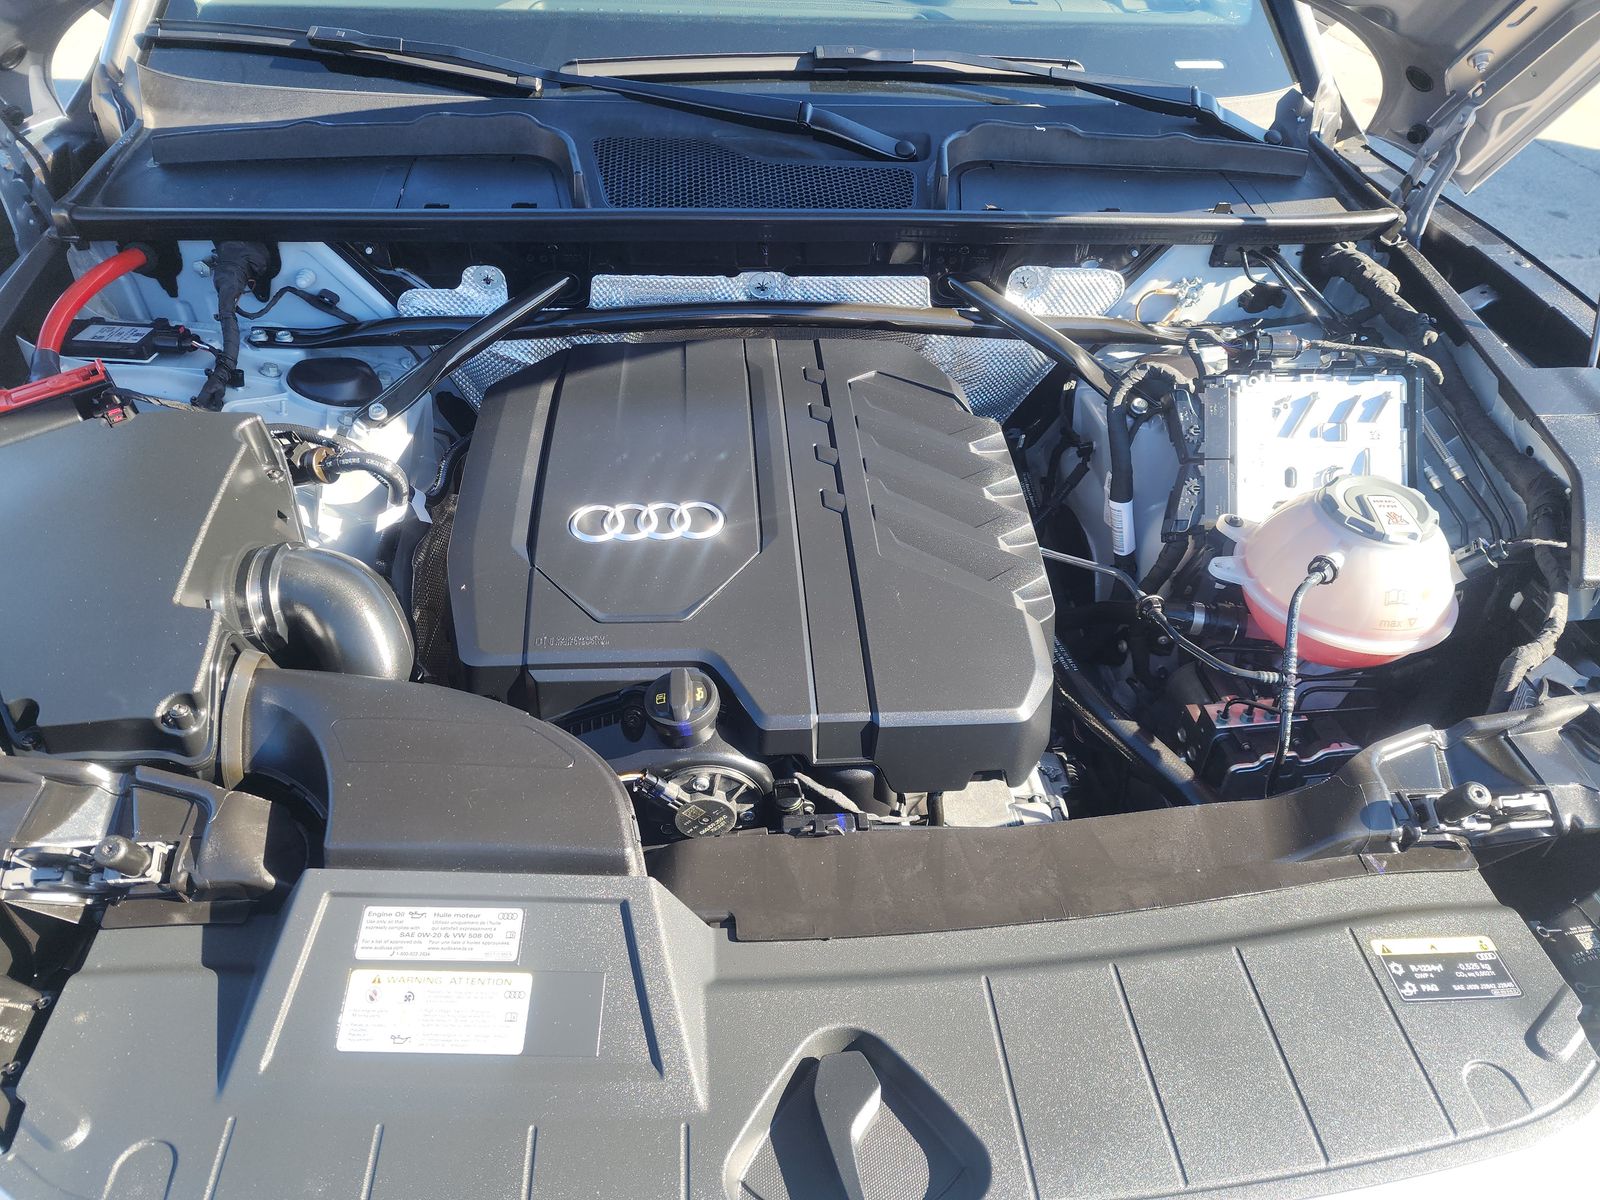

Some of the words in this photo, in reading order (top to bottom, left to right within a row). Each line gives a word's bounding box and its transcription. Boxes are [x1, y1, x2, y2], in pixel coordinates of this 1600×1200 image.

[1379, 619, 1402, 628] max
[367, 911, 393, 919] Engine
[1480, 962, 1492, 971] kg
[387, 976, 442, 985] WARNING
[450, 977, 513, 986] ATTENTION
[1420, 983, 1440, 992] PAG
